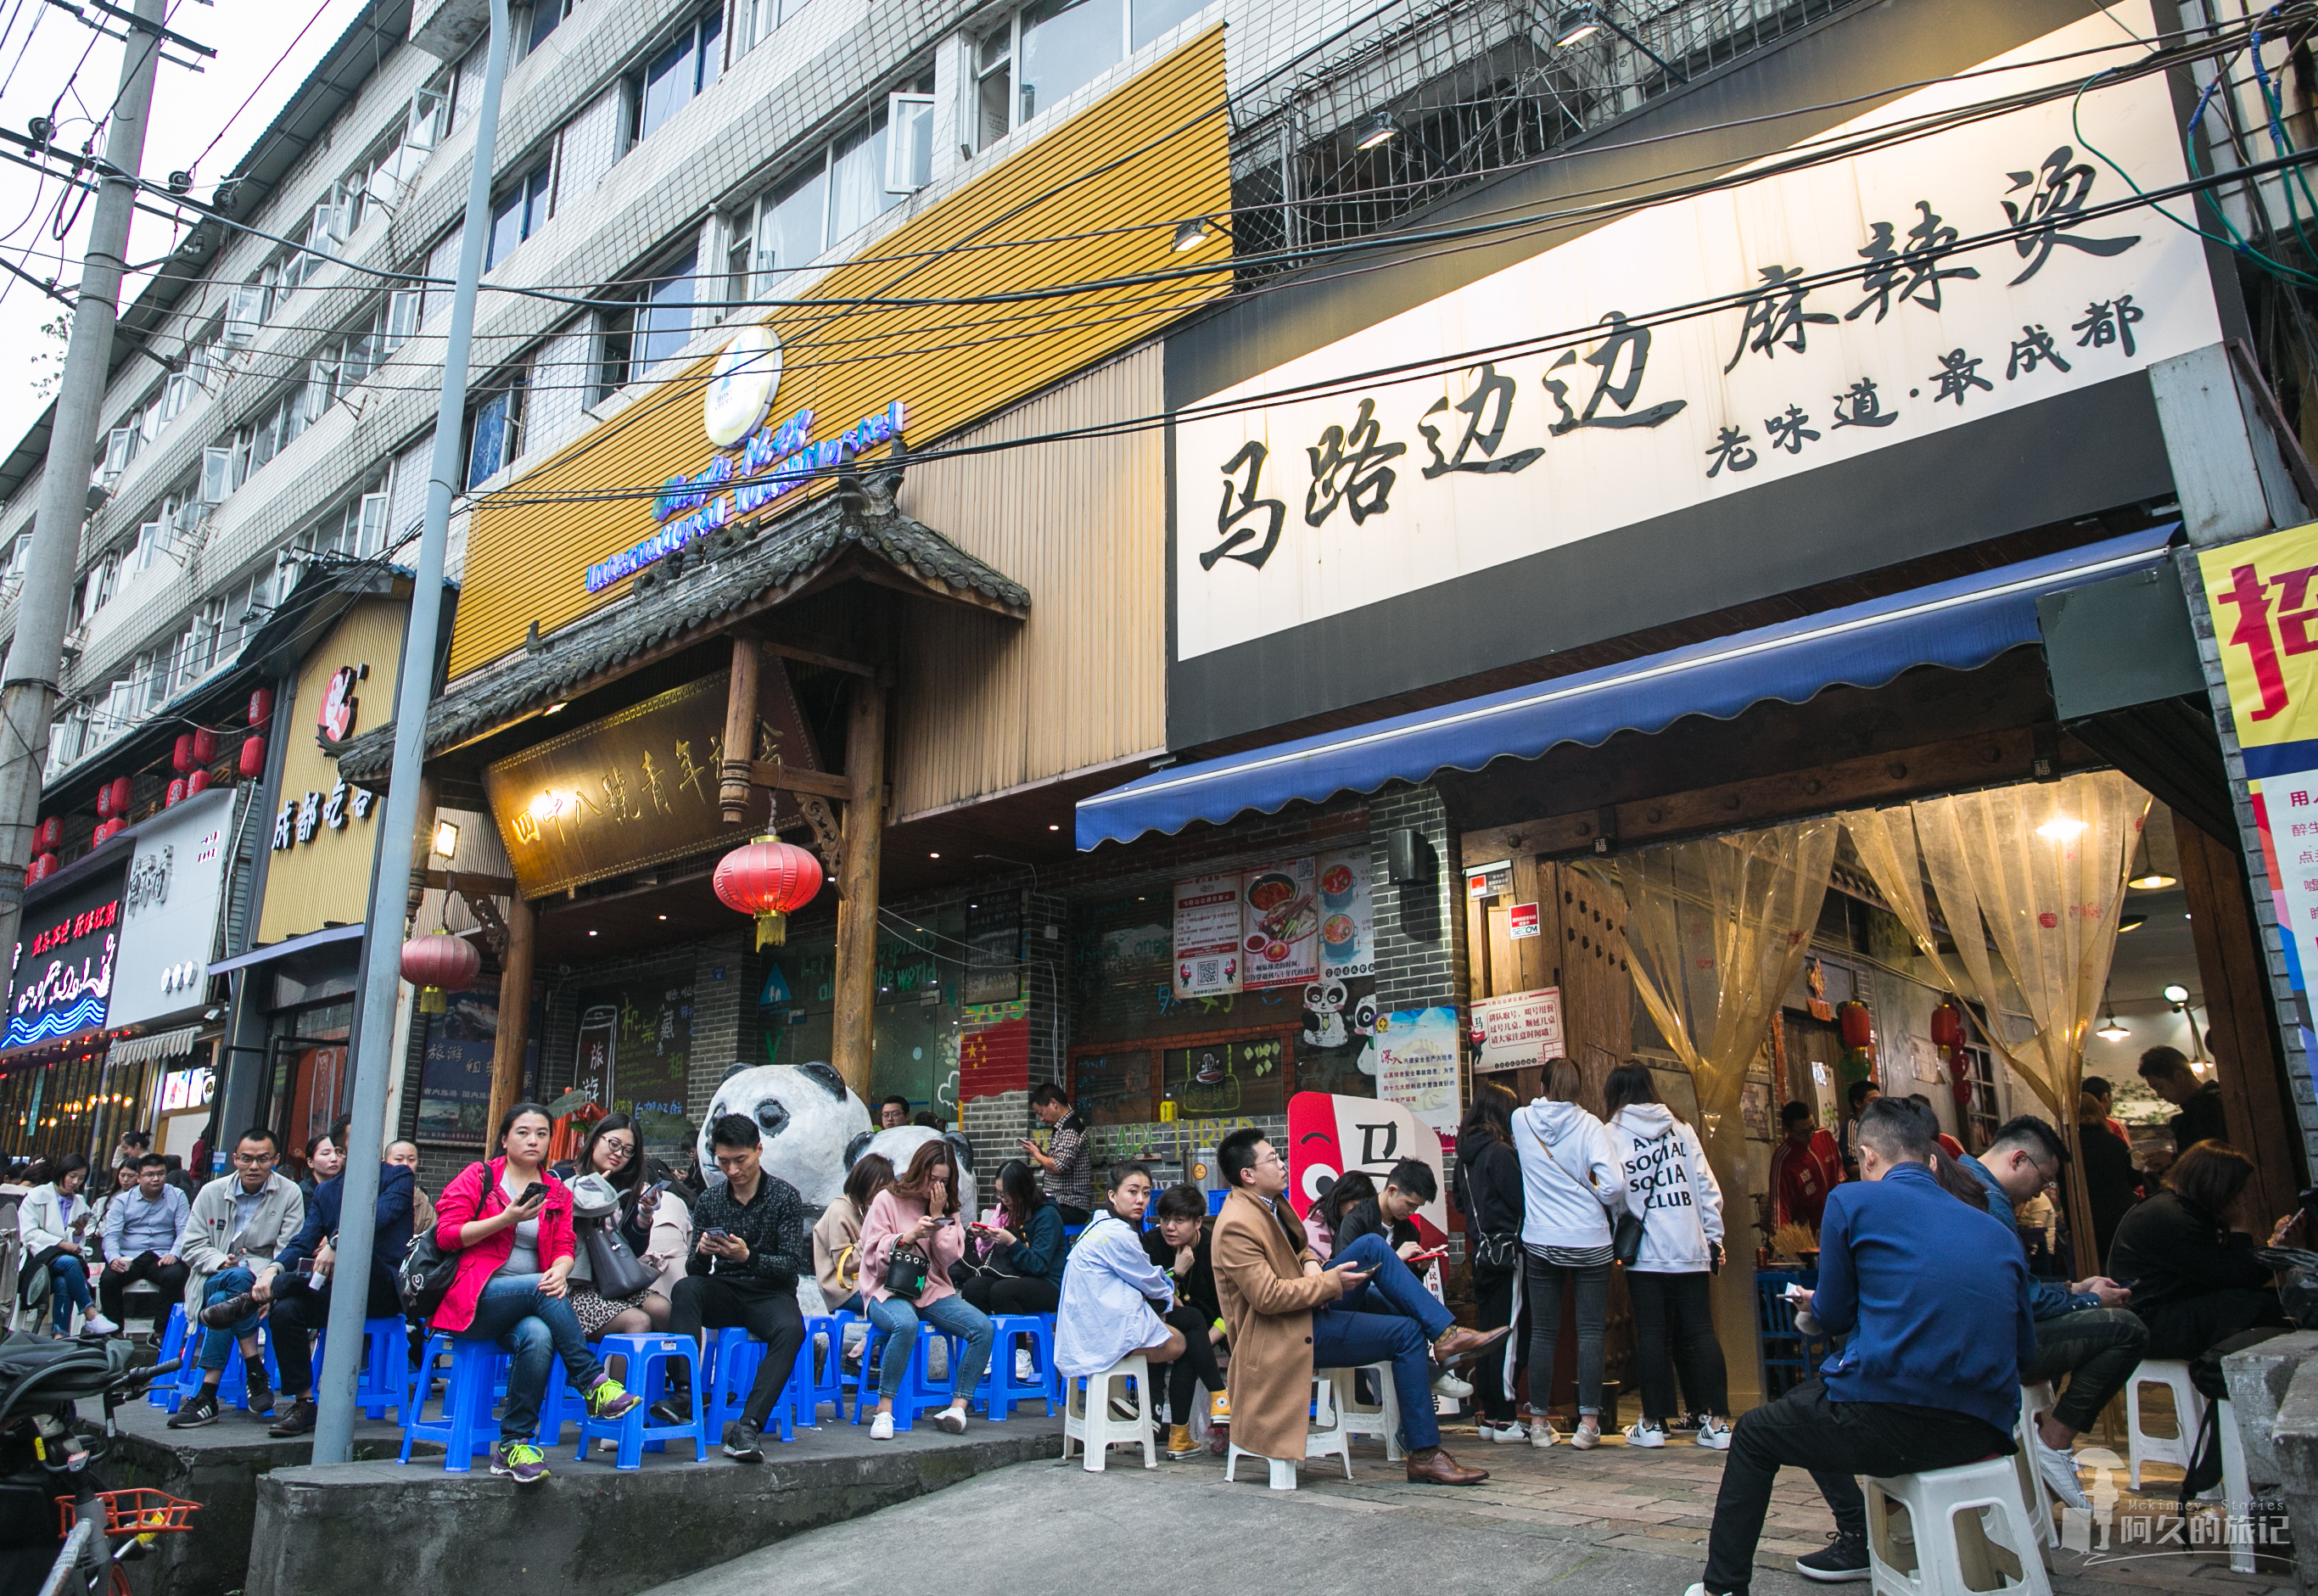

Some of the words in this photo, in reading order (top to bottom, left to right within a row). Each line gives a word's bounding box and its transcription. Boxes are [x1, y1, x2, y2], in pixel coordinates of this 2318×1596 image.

[1199, 311, 1688, 571] 马路边边
[1723, 145, 2141, 374] 麻辣烫
[1705, 294, 2143, 478] 老味道·最成都
[585, 496, 727, 593] International
[734, 453, 808, 514] Youth
[803, 400, 905, 473] Hostel
[1594, 837, 1607, 853] 福
[1513, 926, 1538, 936] SECOM
[897, 955, 937, 987] world
[1474, 1016, 1483, 1029] 马
[428, 1043, 463, 1063] 旅游
[1625, 1142, 1687, 1174] SOCIAL
[1643, 1190, 1692, 1209] CLUB
